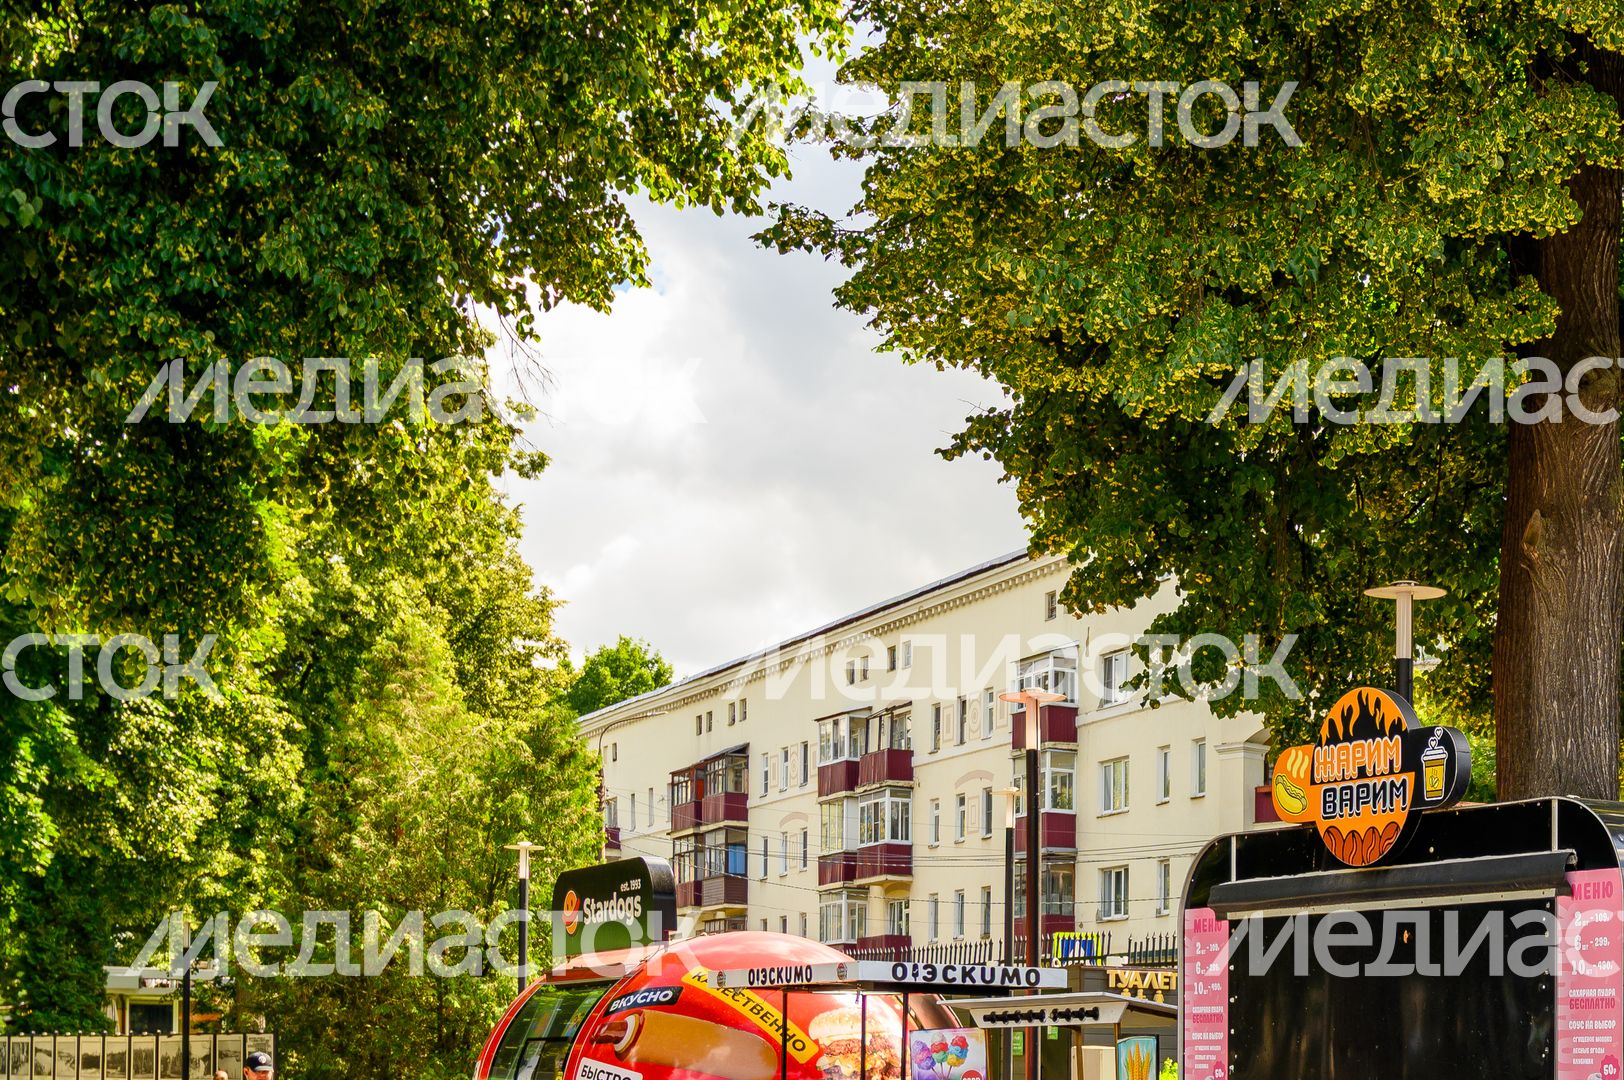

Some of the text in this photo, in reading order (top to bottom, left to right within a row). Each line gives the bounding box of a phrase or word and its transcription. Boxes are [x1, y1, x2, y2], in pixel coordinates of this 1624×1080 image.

[1314, 735, 1402, 783] ЖАРИМ
[1321, 776, 1408, 820] ВАРИМ
[630, 879, 642, 891] 1993
[1572, 881, 1614, 900] МЕНЮ
[583, 891, 642, 926] Stardogs
[608, 990, 674, 1012] ВКУСНО
[1570, 998, 1616, 1010] БЕСПЛАТНО
